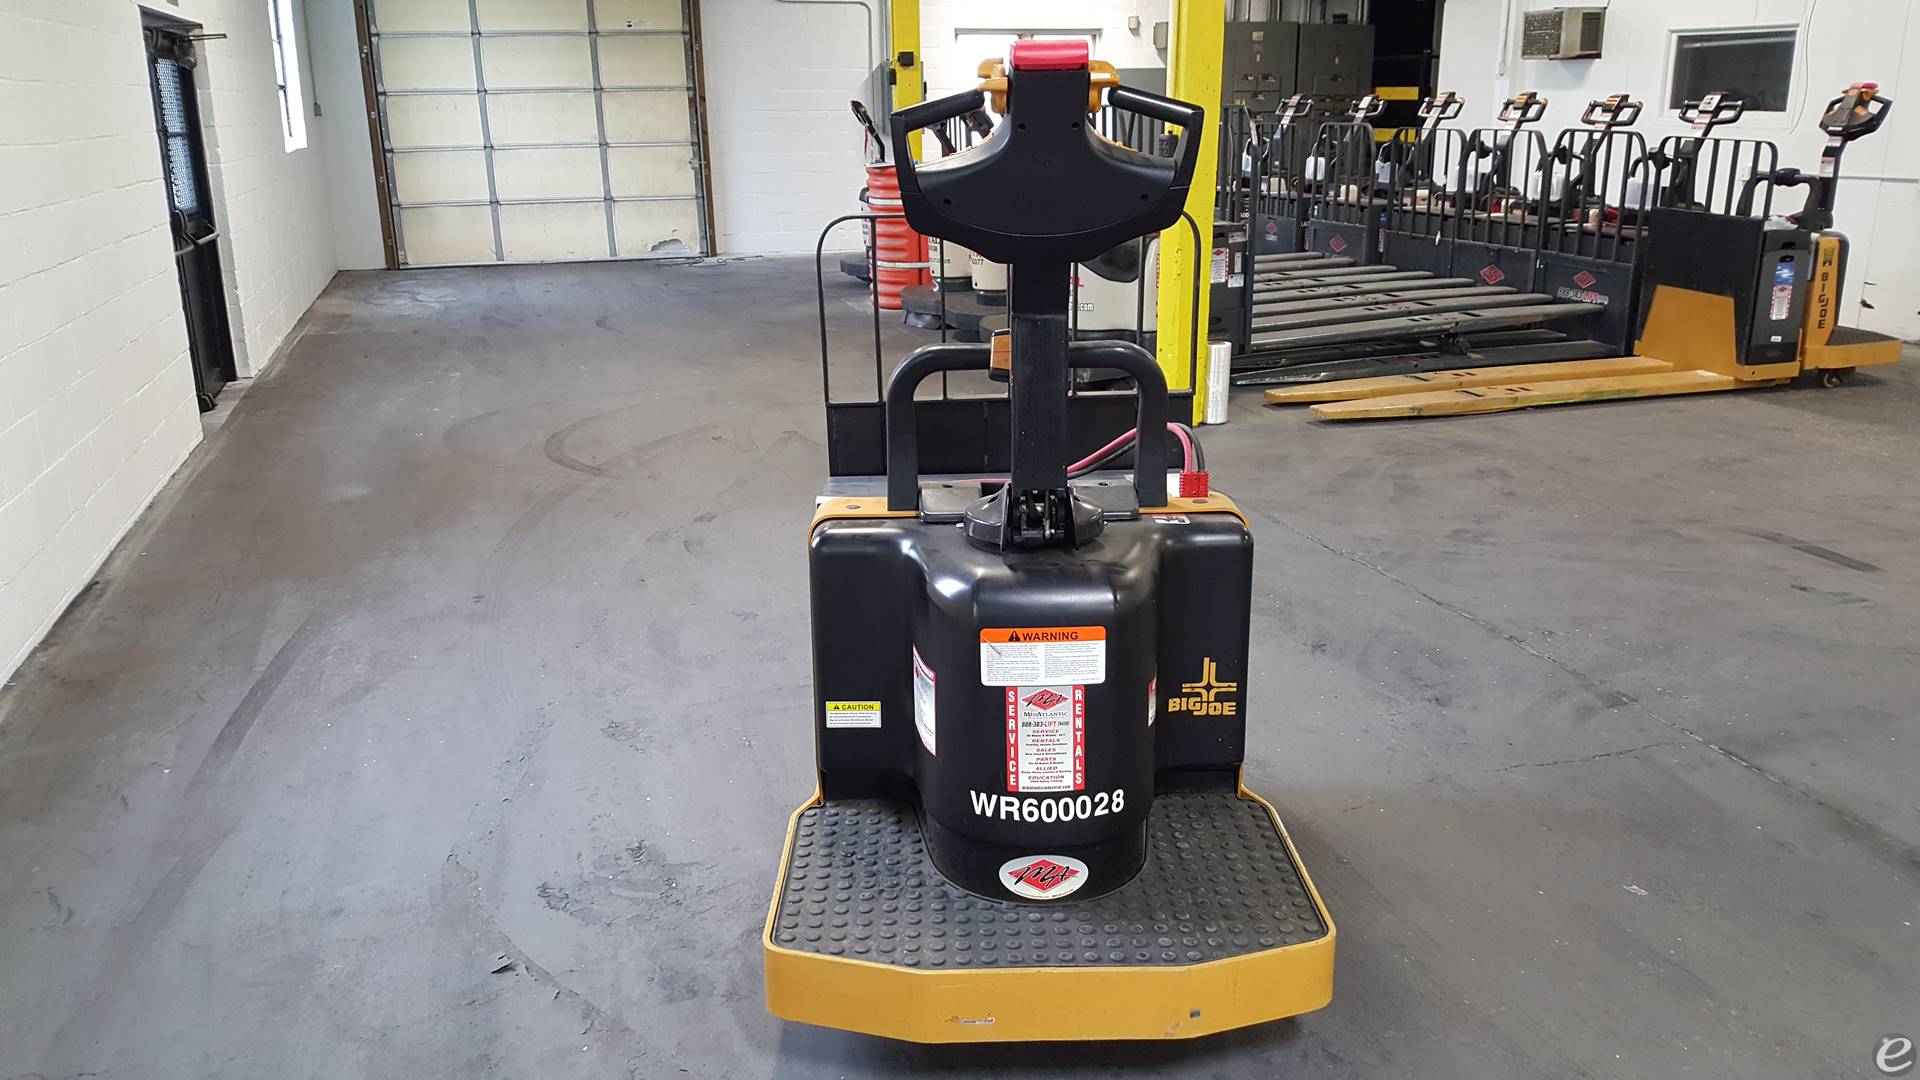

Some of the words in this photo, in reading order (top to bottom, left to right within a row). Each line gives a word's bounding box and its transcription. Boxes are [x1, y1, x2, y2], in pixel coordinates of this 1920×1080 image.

[1022, 631, 1079, 641] WARNING
[1008, 691, 1016, 785] SERVICE
[1075, 689, 1083, 784] RENTALS
[969, 788, 1125, 823] WR600028
